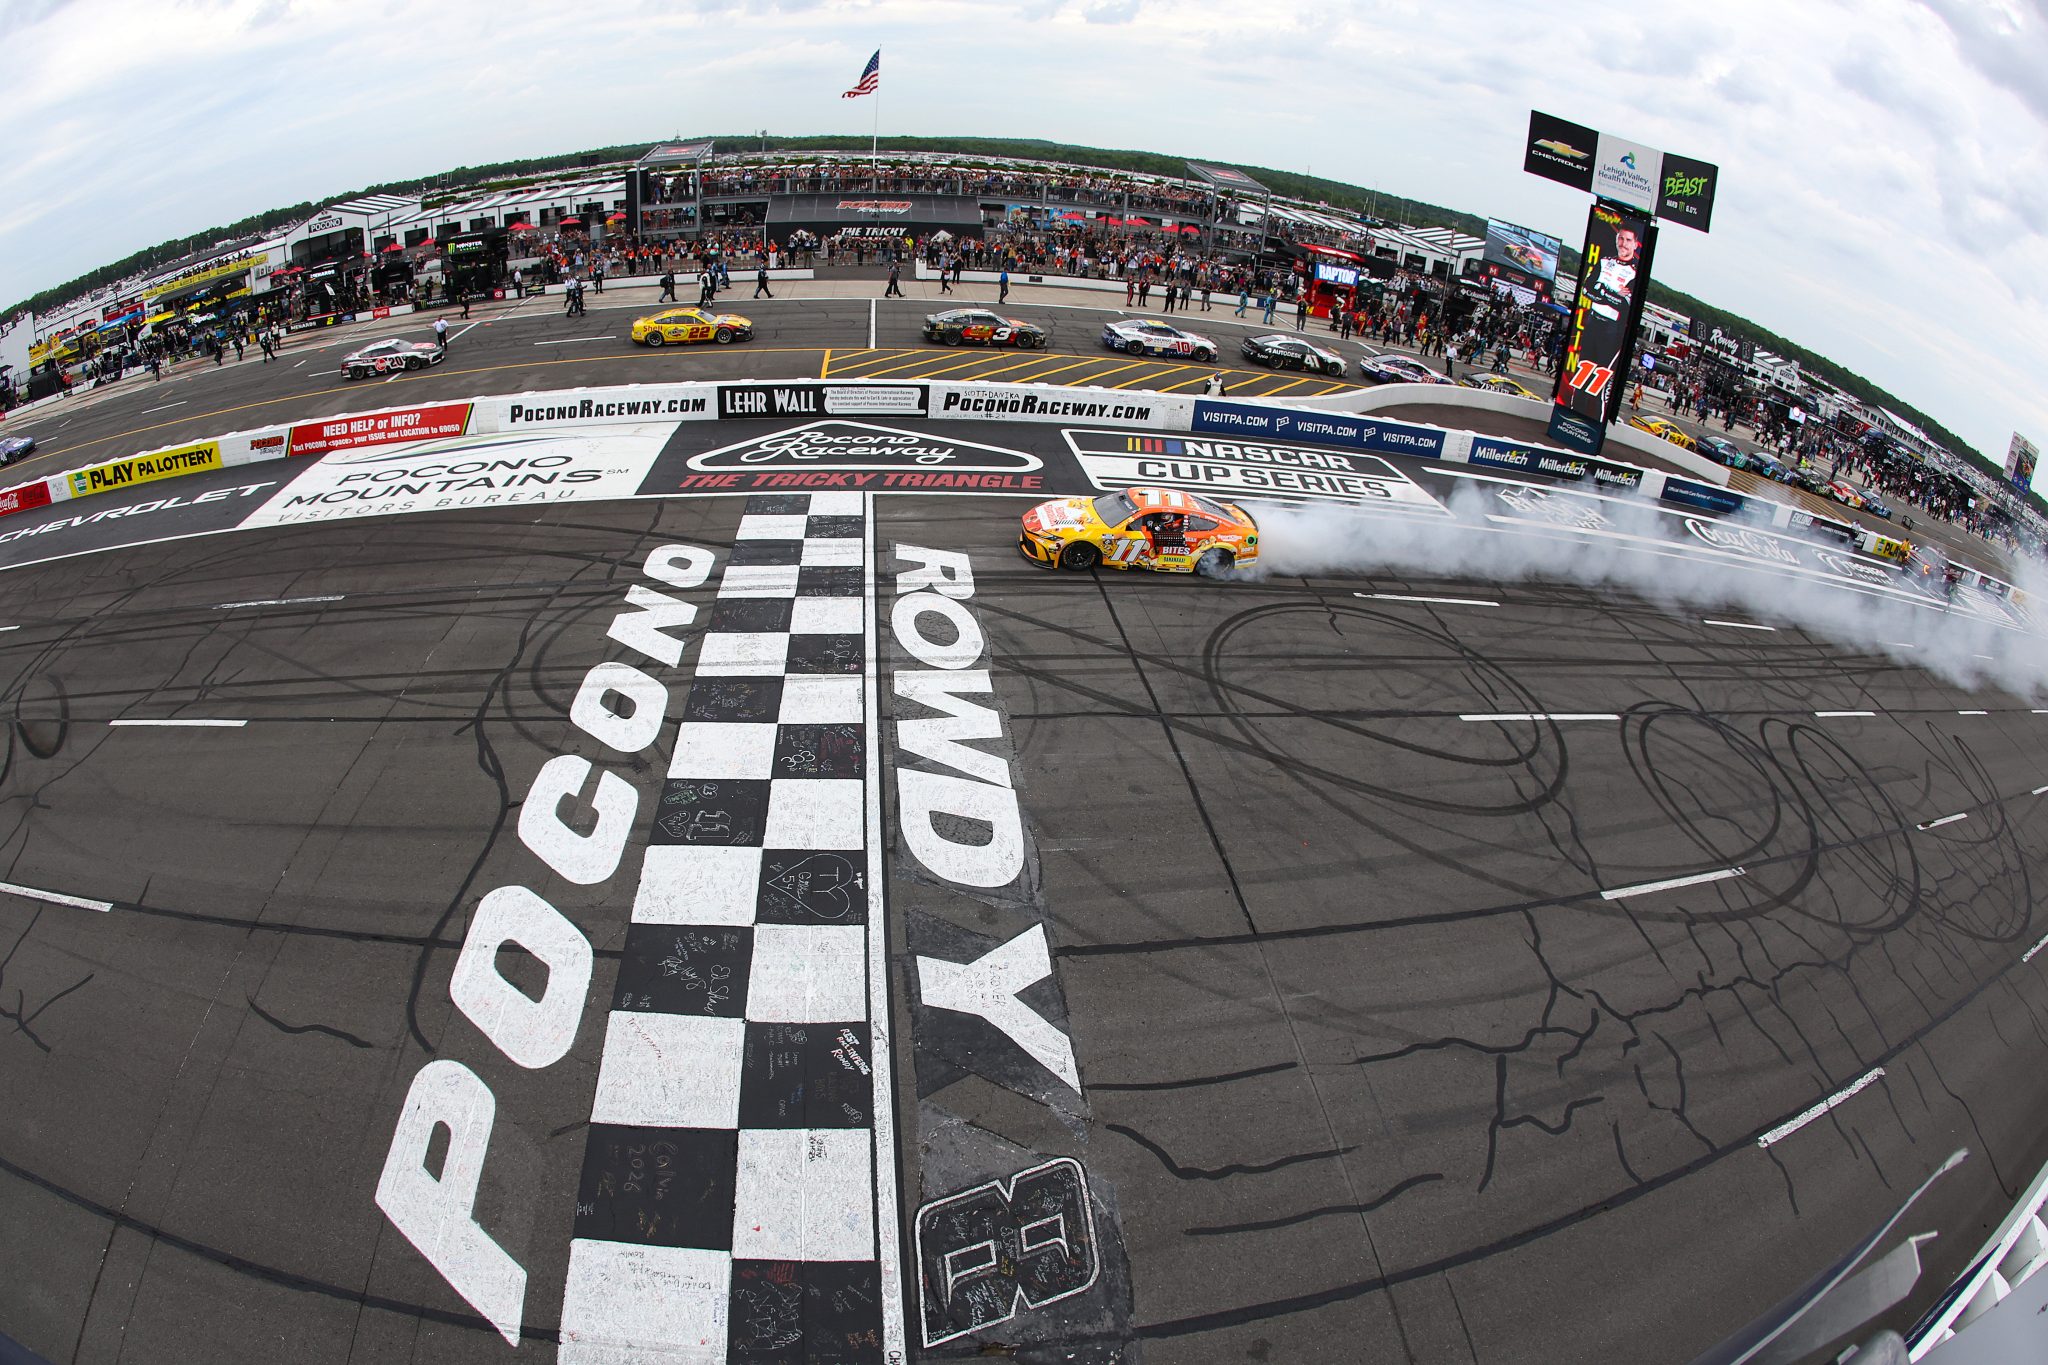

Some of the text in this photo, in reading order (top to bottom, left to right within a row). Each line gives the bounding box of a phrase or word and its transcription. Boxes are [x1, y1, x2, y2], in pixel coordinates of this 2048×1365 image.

[1532, 150, 1589, 172] CHEVROLET
[1598, 170, 1622, 184] Health
[1622, 176, 1652, 194] Network
[1603, 164, 1648, 185] Lehigh Valley
[1665, 177, 1708, 197] BEAST
[310, 219, 341, 232] POCONO
[841, 227, 907, 236] THE TRICKY
[1318, 265, 1356, 285] RAPTOR
[327, 317, 334, 325] 2
[688, 326, 710, 339] 22
[993, 328, 1012, 341] 3
[1710, 328, 1739, 355] Rowdy
[1176, 341, 1191, 353] 10
[1272, 348, 1303, 359] AUTODESK
[390, 356, 403, 367] 20
[1304, 354, 1320, 368] 41
[1569, 359, 1614, 397] 11
[725, 389, 817, 414] LEHR WALL
[323, 413, 421, 438] NEED HELP or INFO?
[1203, 412, 1268, 428] VISITPA.COM
[1297, 421, 1357, 438] VISITPA.COM
[1563, 422, 1590, 437] POCONO
[292, 444, 304, 452] Text
[304, 440, 326, 450] POCONO
[353, 435, 367, 445] your
[368, 432, 386, 442] ISSUE
[387, 430, 399, 439] and
[400, 426, 430, 437] LOCATION
[431, 426, 438, 434] to
[1382, 432, 1437, 449] VISITPA.COM
[1557, 424, 1592, 444] MOUNTAINS
[741, 441, 957, 465] Raceway
[1186, 441, 1356, 471] NASCAR
[1475, 446, 1529, 466] Millertech
[91, 448, 214, 489] PLAY PA LOTTERY
[336, 455, 573, 487] POCONO
[1538, 457, 1586, 477] Millertech
[680, 472, 1044, 489] THE TRICKY TRIANGLE
[1137, 461, 1393, 498] CUP SERIES
[1594, 468, 1637, 488] Millertech
[282, 469, 603, 509] MOUNTAINS
[279, 489, 576, 523] VISITORS BUREAU
[1109, 538, 1147, 562] 11
[1162, 546, 1191, 556] BITES
[891, 543, 1082, 1098] ROWDY
[812, 866, 840, 901] TY
[375, 543, 716, 1349] POCONO
[840, 1028, 859, 1047] REST
[624, 1148, 644, 1193] 2026
